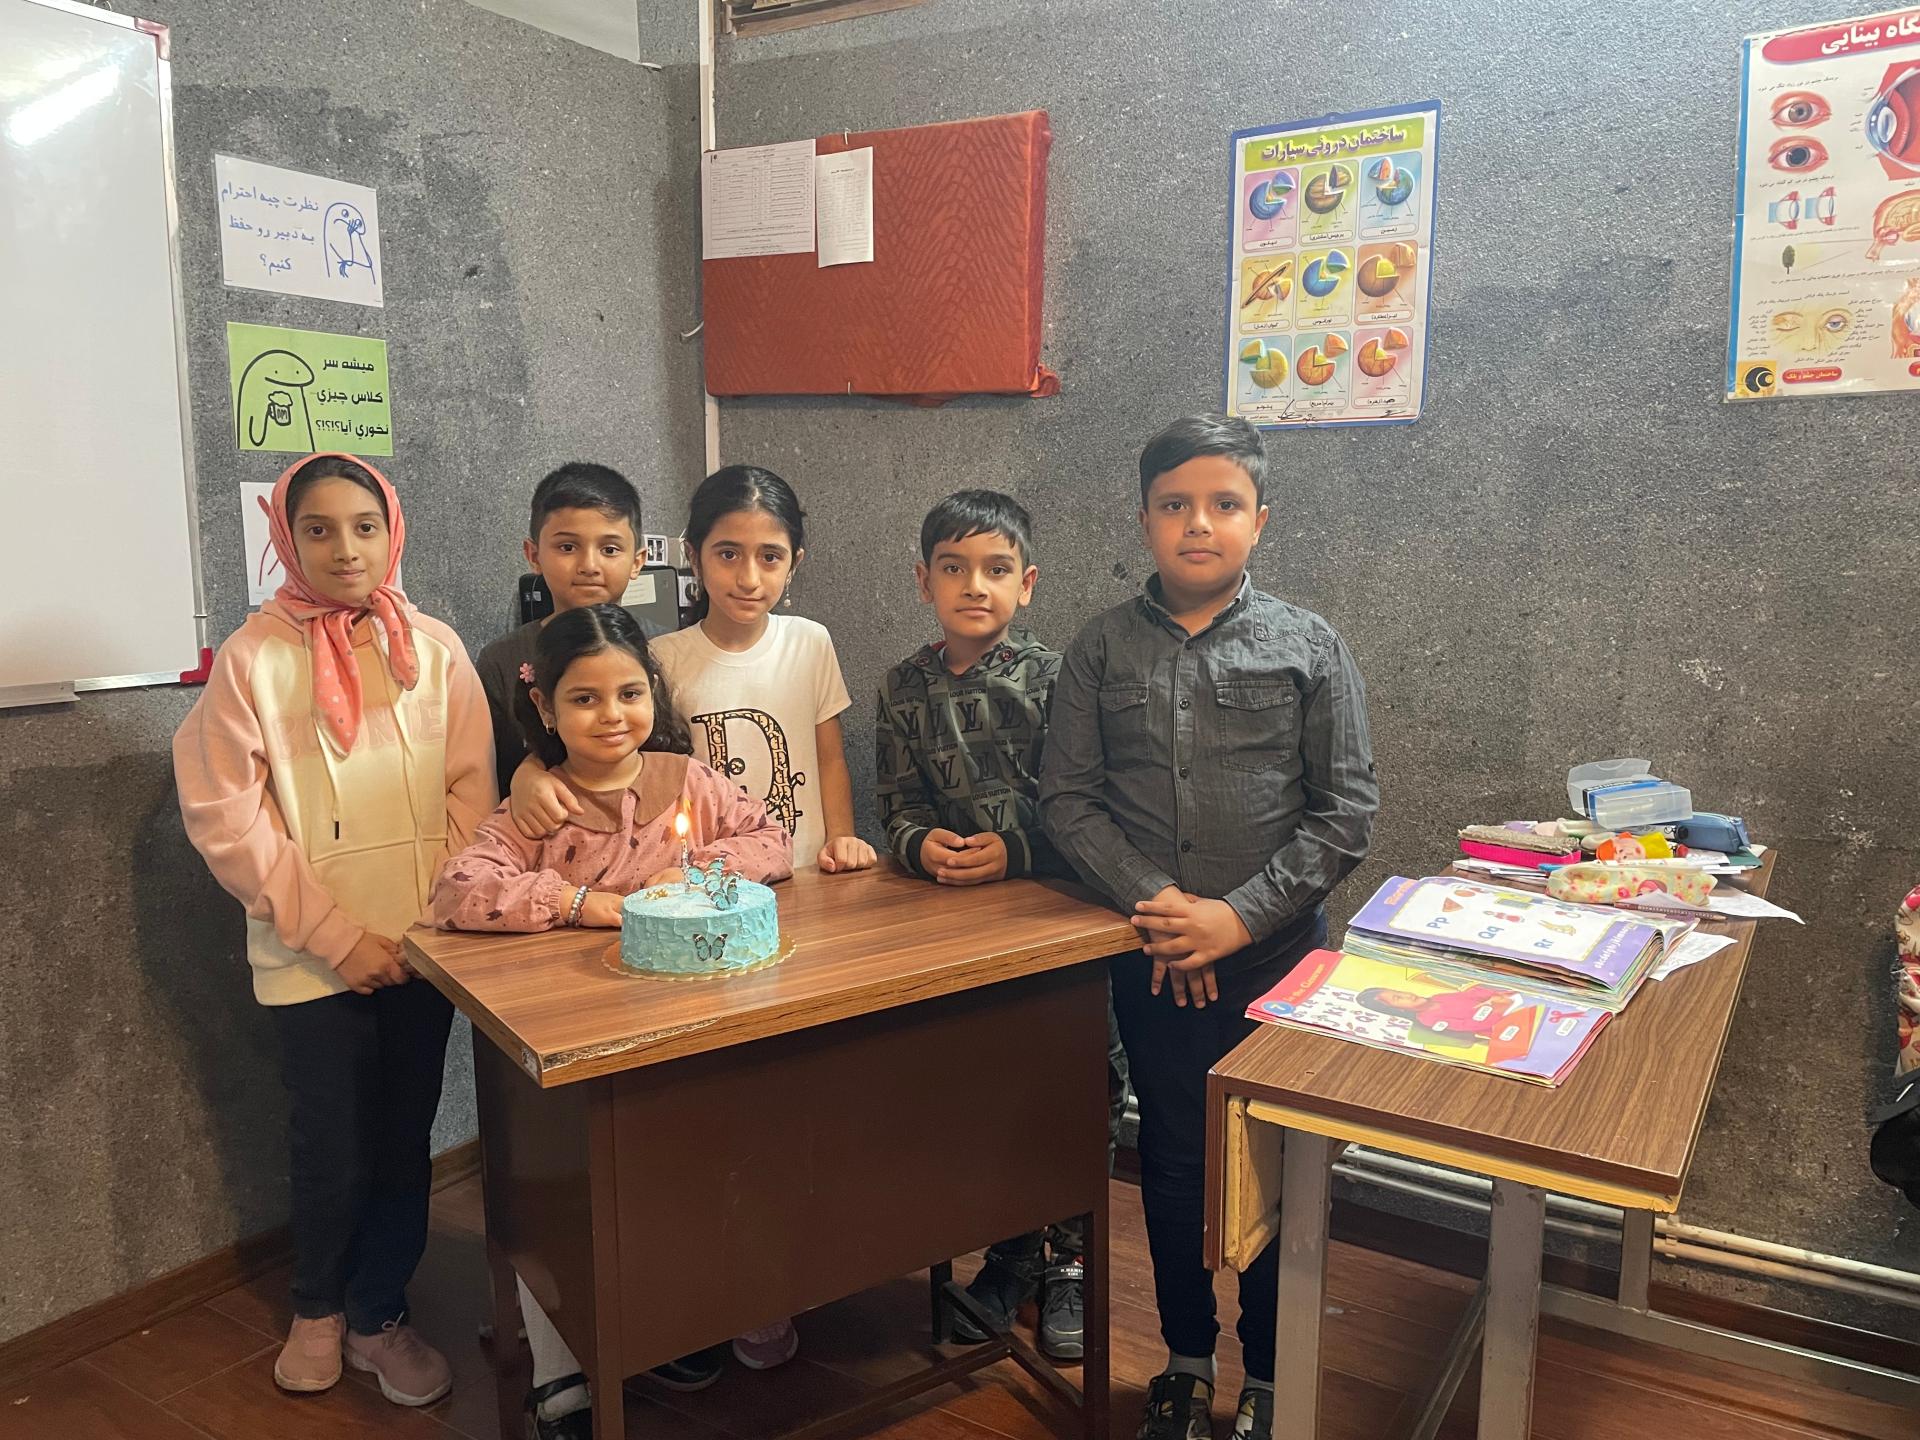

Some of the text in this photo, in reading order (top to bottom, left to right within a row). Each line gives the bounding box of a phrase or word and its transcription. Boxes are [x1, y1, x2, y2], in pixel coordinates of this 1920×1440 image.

[1821, 25, 1880, 54] بینایی
[1262, 125, 1406, 161] ساختمان درونی سیارات
[221, 182, 319, 212] نظرت چیه احترام
[229, 215, 315, 245] به دبیر رو حفظ
[322, 357, 374, 373] میشه سر
[351, 391, 383, 405] کلاس
[1426, 917, 1450, 929] Pp
[1478, 925, 1505, 939] Qq
[1534, 939, 1555, 950] Rr
